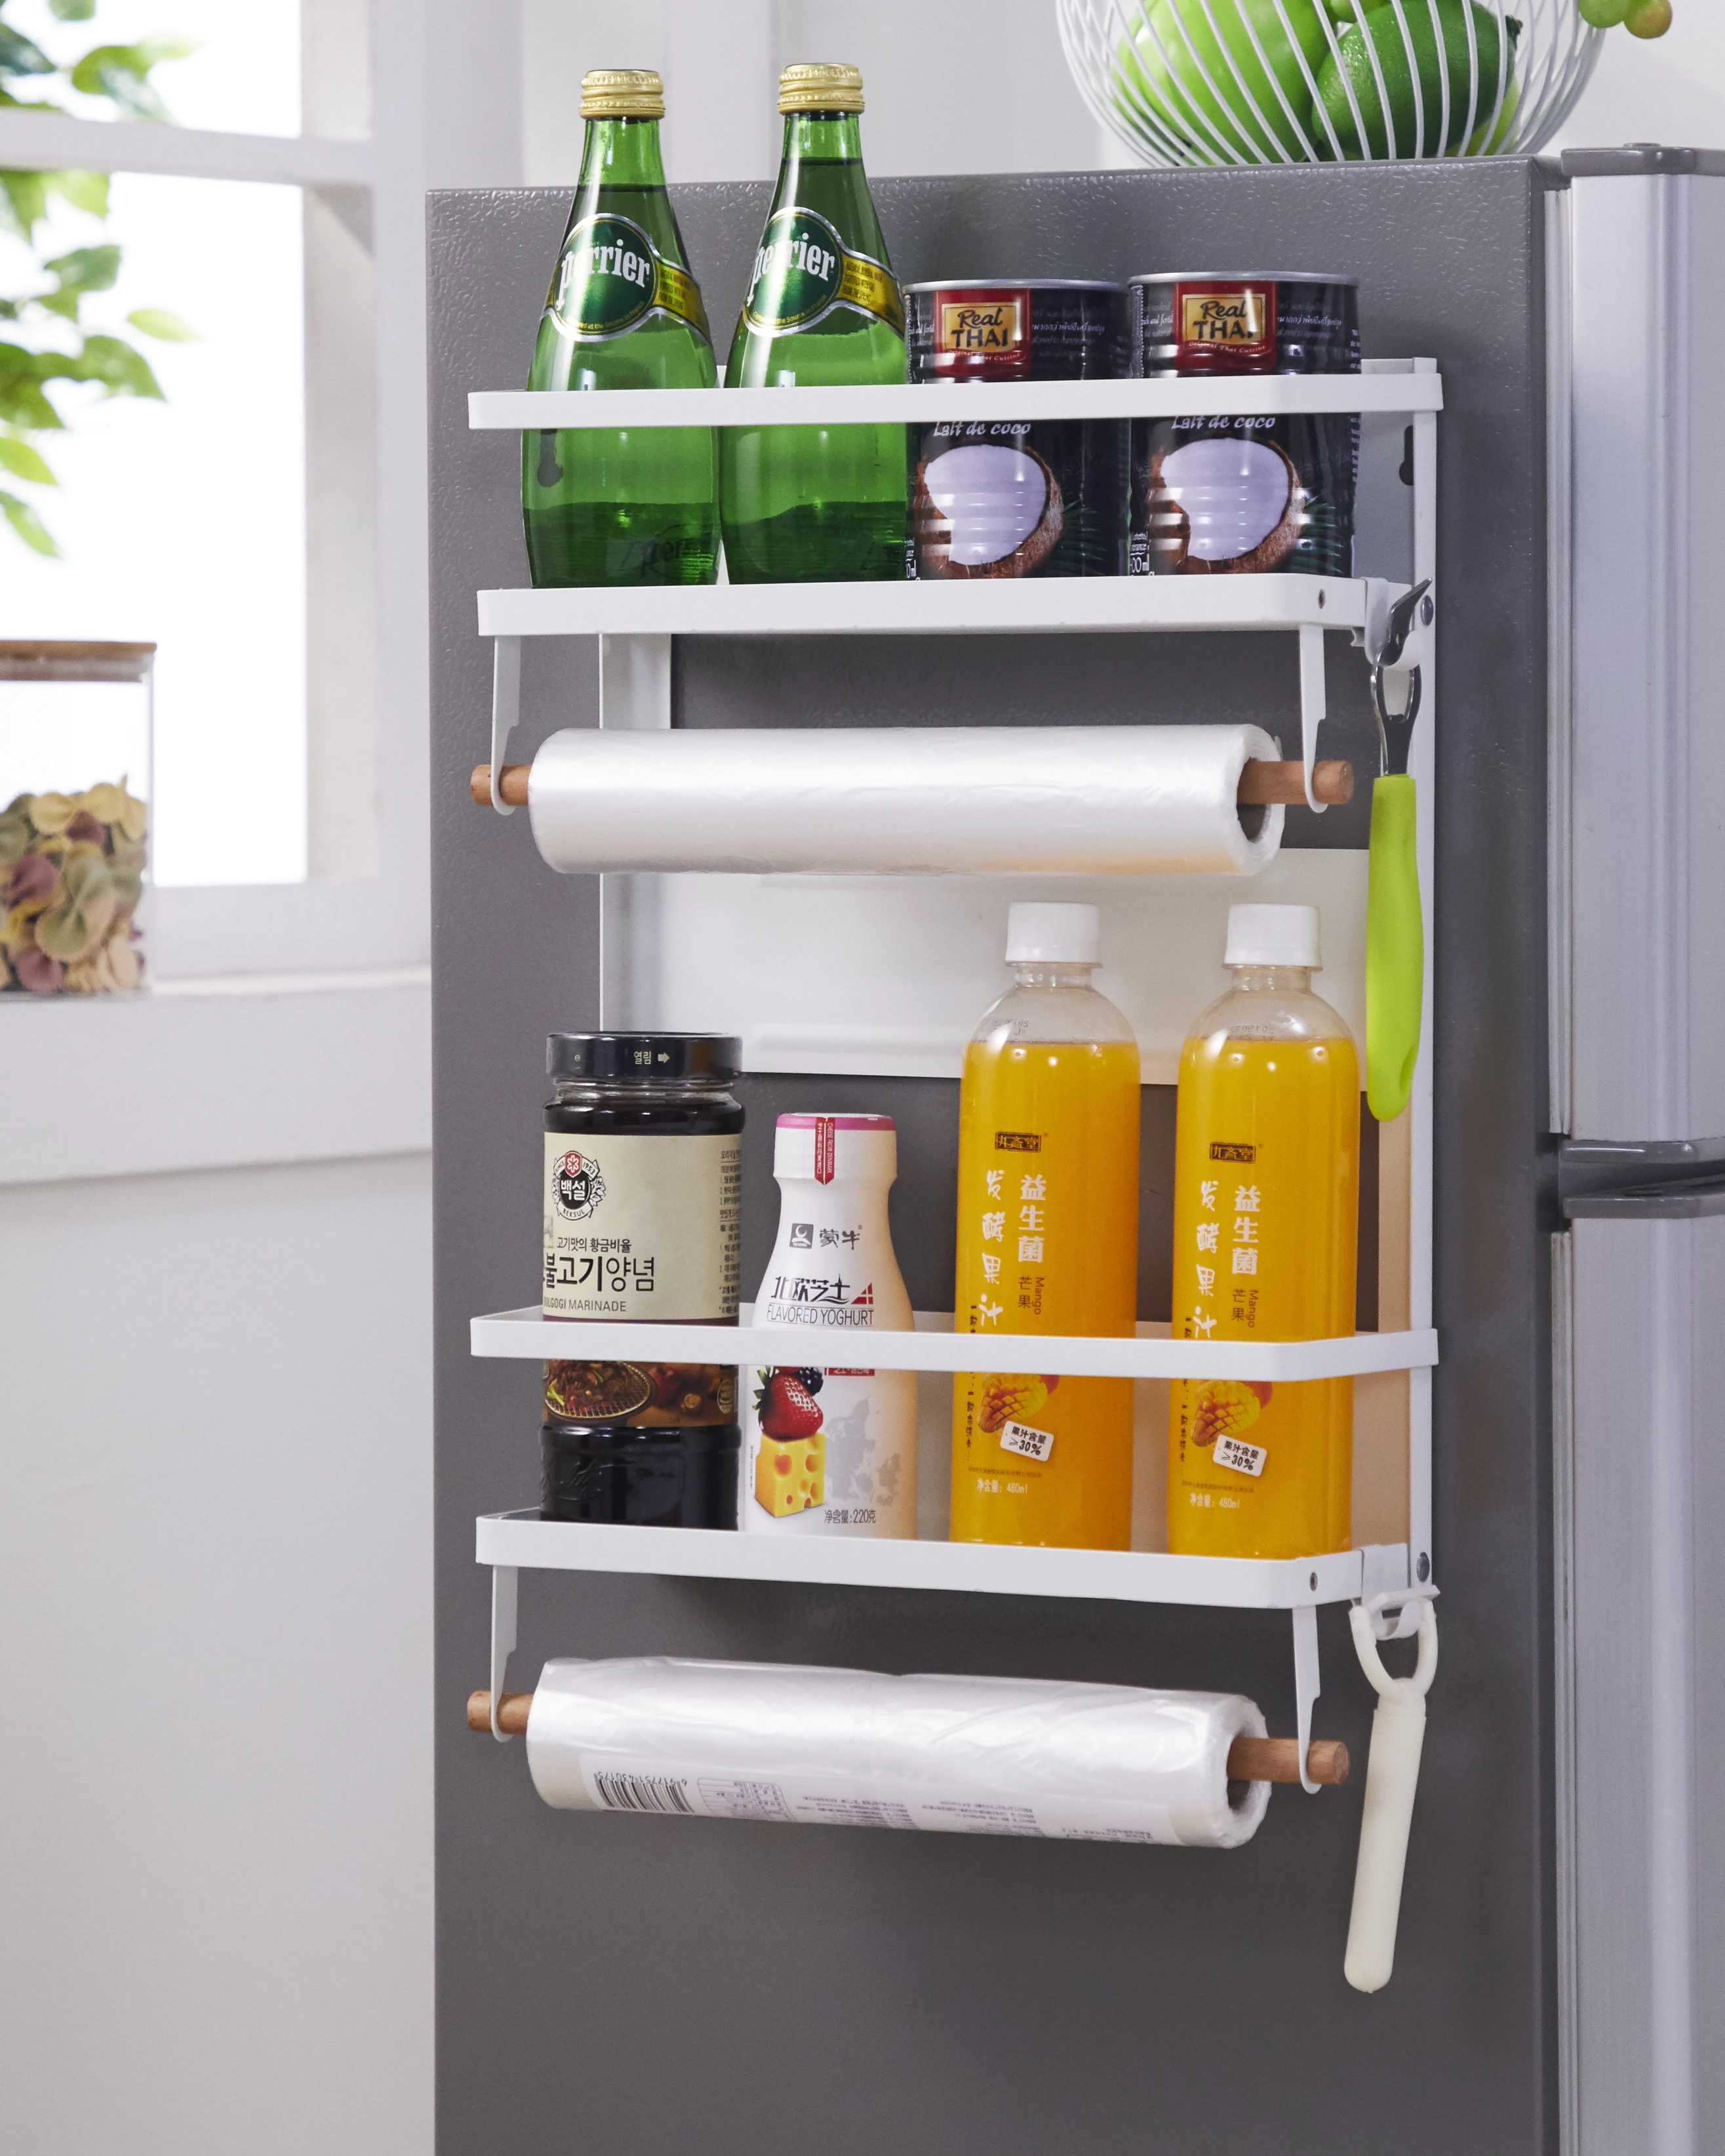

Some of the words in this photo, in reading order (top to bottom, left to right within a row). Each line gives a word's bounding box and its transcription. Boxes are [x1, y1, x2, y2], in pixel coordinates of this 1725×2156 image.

[957, 307, 1004, 328] Real
[1200, 300, 1246, 320] Real
[951, 328, 1009, 348] THAI
[966, 421, 987, 435] de
[990, 423, 1031, 435] coco
[1208, 415, 1231, 429] de
[1234, 416, 1276, 428] coco
[633, 1051, 652, 1065] 열림
[583, 1162, 596, 1175] 1953
[561, 1180, 585, 1201] 백설
[563, 1208, 585, 1217] BEKSUL
[1018, 1174, 1046, 1263] 益生菌
[819, 1228, 860, 1251] 蒙牛
[1232, 1185, 1261, 1275] 益生菌
[557, 1237, 587, 1251] 고기맛의
[590, 1238, 631, 1253] 황금비율
[544, 1256, 654, 1292] 불고기양념
[569, 1299, 627, 1312] MARINADE
[1032, 1277, 1045, 1315] Mango
[766, 1304, 818, 1324] FLAVORED
[821, 1310, 875, 1326] YOGHURT
[1247, 1289, 1259, 1329] Mango
[1011, 1426, 1047, 1445] 果汁含量
[1223, 1440, 1259, 1460] 果汁含量
